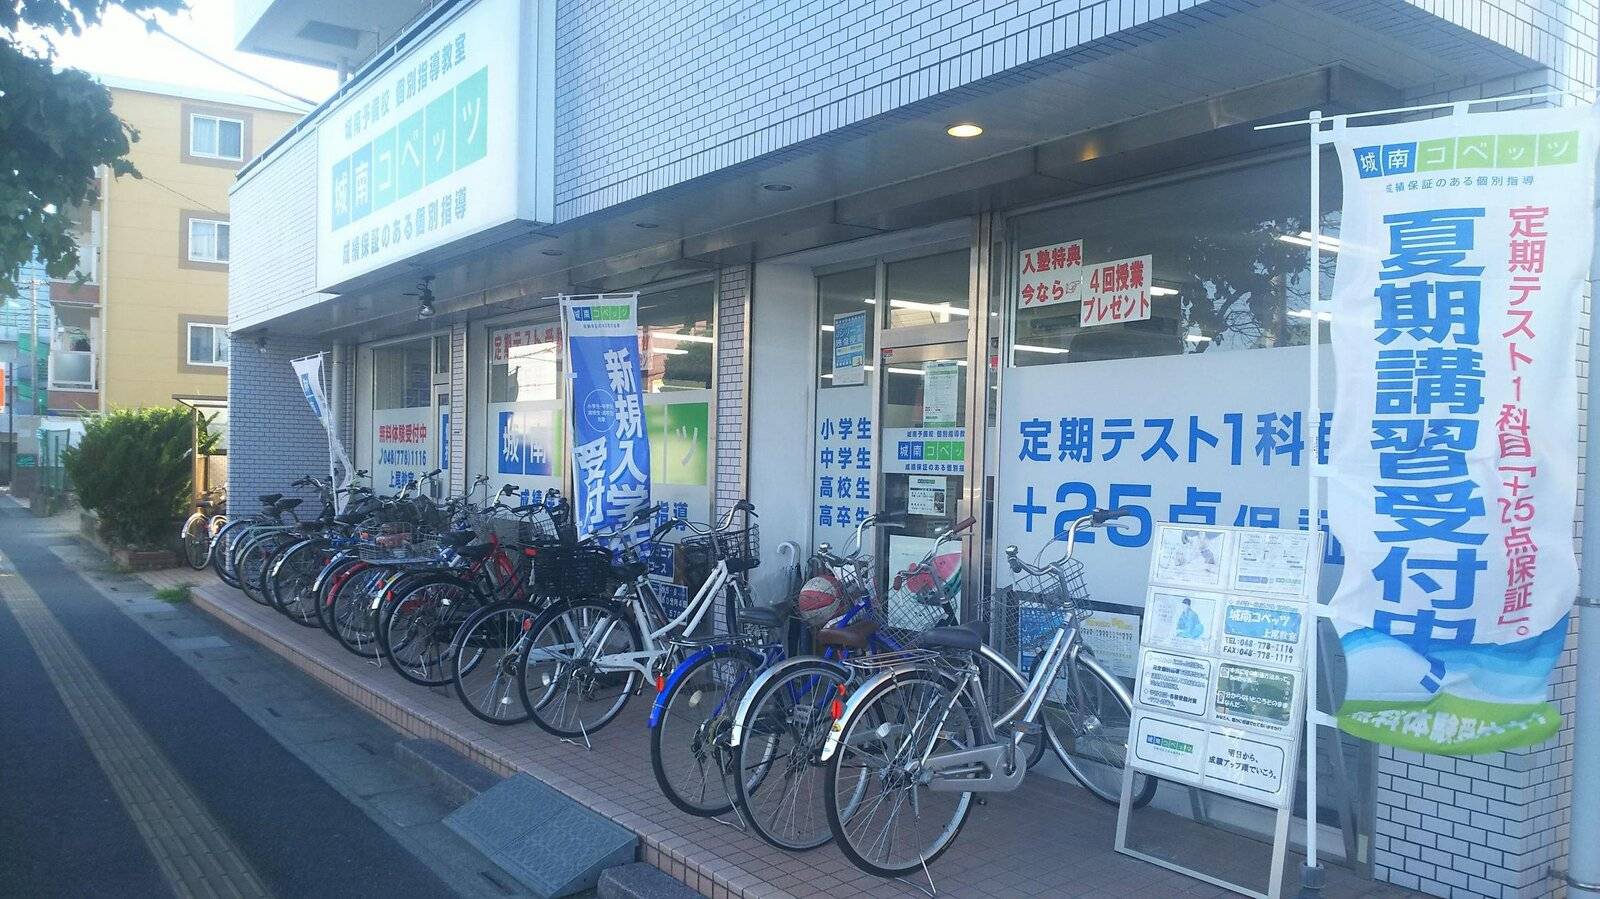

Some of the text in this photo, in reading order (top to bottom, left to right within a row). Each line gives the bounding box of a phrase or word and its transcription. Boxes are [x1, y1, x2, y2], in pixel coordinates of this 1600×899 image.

[1360, 139, 1571, 172] 城南コベッツ
[1022, 243, 1081, 275] 入塾特典
[1090, 260, 1144, 294] 4回授業
[1021, 280, 1064, 305] 今なら
[1083, 291, 1150, 323] プレゼント
[821, 417, 871, 440] 小学生
[821, 447, 870, 469] 中学生
[1371, 207, 1489, 693] 夏期講習受付中
[520, 489, 560, 508] 成績
[820, 476, 870, 499] 高校生
[819, 505, 870, 528] 高卒生
